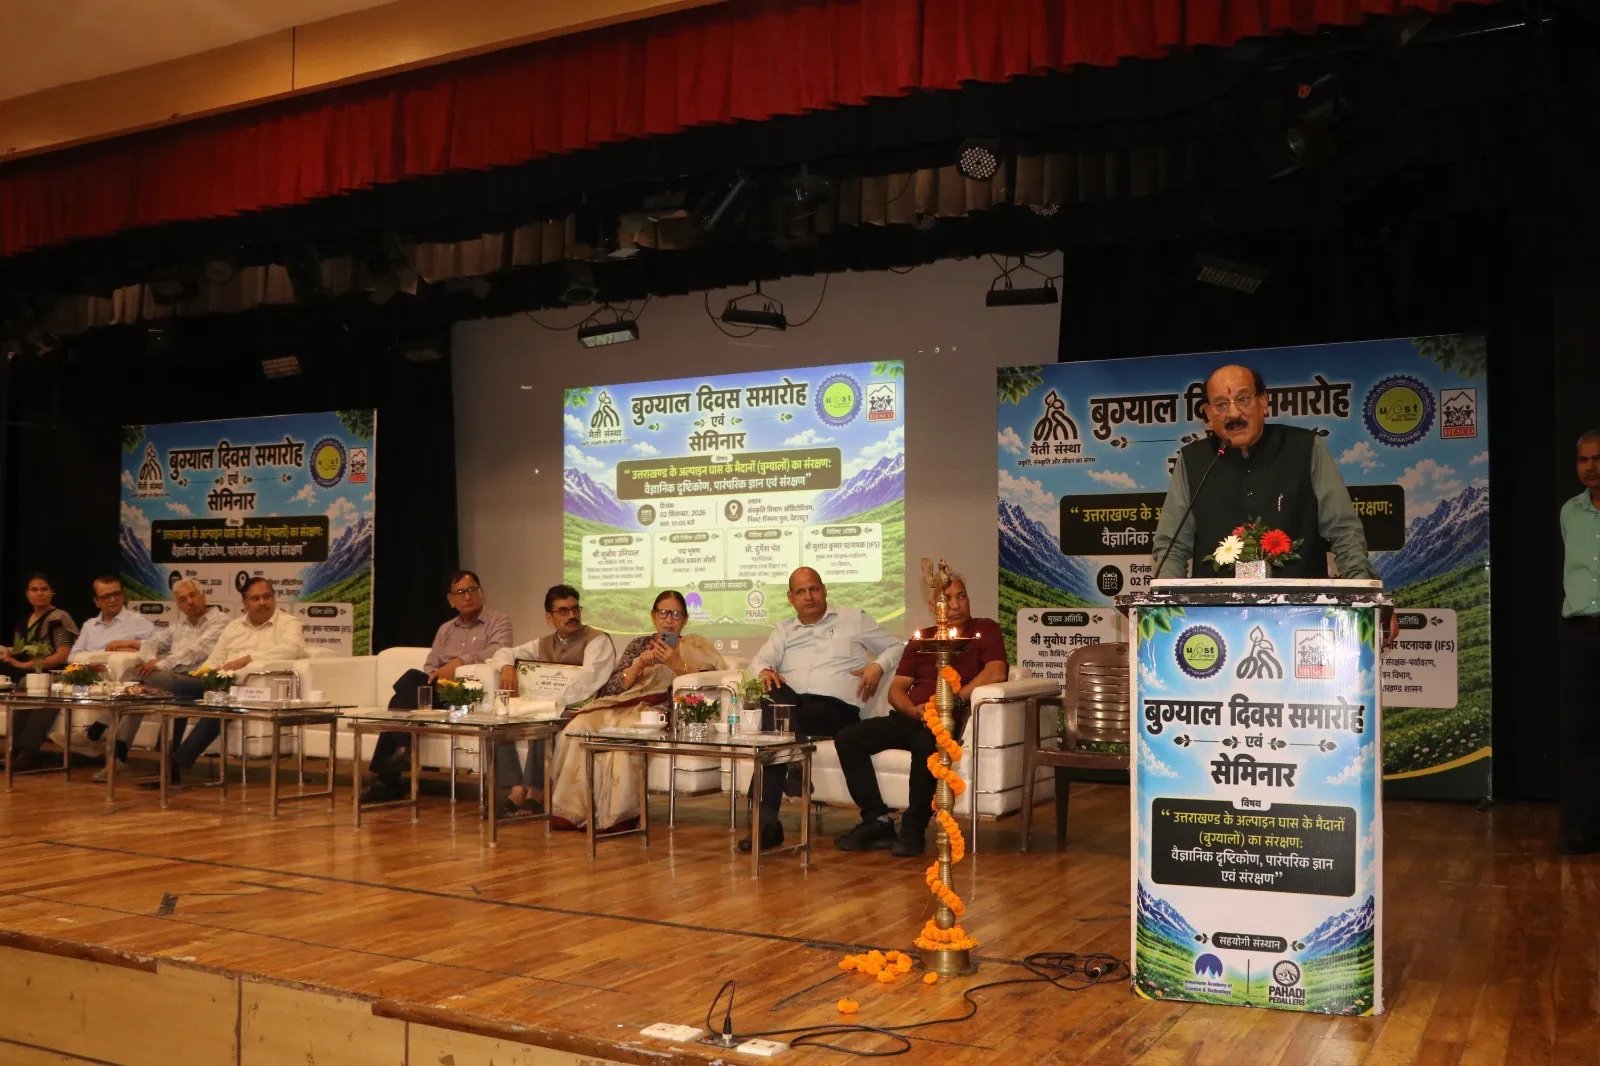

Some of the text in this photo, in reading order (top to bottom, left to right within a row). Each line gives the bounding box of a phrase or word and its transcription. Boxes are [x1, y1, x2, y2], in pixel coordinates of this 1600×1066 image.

[631, 393, 691, 425] बुग्याल
[696, 385, 741, 412] दिवस
[746, 378, 808, 407] समारोह
[711, 414, 725, 427] एवं
[1090, 394, 1179, 440] बुग्याल
[589, 428, 622, 439] मैती संस्था
[1379, 430, 1421, 442] UTTARAKHAND
[1444, 427, 1474, 437] HESCO
[688, 430, 746, 452] सेमिनार
[1030, 442, 1082, 455] मैती संस्था
[169, 438, 304, 480] बुग्याल दिवस समारोह
[1034, 458, 1050, 467] संस्कृति
[632, 456, 832, 480] उत्तराखण्ड के अल्पाइन घास के मैदानों (बुग्यालों) का संरक्षण:
[228, 471, 238, 486] एवं
[644, 481, 675, 495] वैज्ञानिक
[676, 479, 712, 496] दृष्टिकोण,
[714, 476, 746, 490] पारंपरिक
[748, 478, 764, 490] ज्ञान
[766, 476, 778, 488] एवं
[208, 488, 256, 511] सेमिनार
[1083, 508, 1138, 522] उत्तराखण्ड
[1140, 502, 1152, 520] के
[1102, 527, 1149, 548] वैज्ञानिक
[828, 542, 842, 551] कुमार
[1130, 564, 1152, 574] दिनांक
[704, 580, 726, 590] सहयोगी
[1130, 578, 1141, 586] 02
[1048, 614, 1083, 624] मुख्य अतिथि
[1398, 617, 1420, 625] अतिथि
[1030, 633, 1100, 648] श्री सुबोध उनियाल
[1400, 640, 1454, 652] पटनायक (IFS)
[1392, 670, 1412, 681] विभाग,
[1404, 685, 1422, 693] शासन
[1144, 694, 1364, 734] बुग्याल दिवस समारोह
[1245, 733, 1262, 748] एवं
[1210, 753, 1297, 787] सेमिनार
[1240, 798, 1262, 808] विषय
[1174, 810, 1345, 832] उत्तराखण्ड के अल्पाइन घास के मैदानों
[1199, 830, 1303, 849] (बुग्यालों) का संरक्षण:
[1171, 846, 1334, 871] वैज्ञानिक दृष्टिकोण, पारंपरिक ज्ञान
[1221, 868, 1236, 882] एवं
[1220, 934, 1280, 950] सहयोगी संस्थान
[1268, 986, 1306, 998] PAHADI
[1268, 996, 1305, 1006] PEDALLERS
